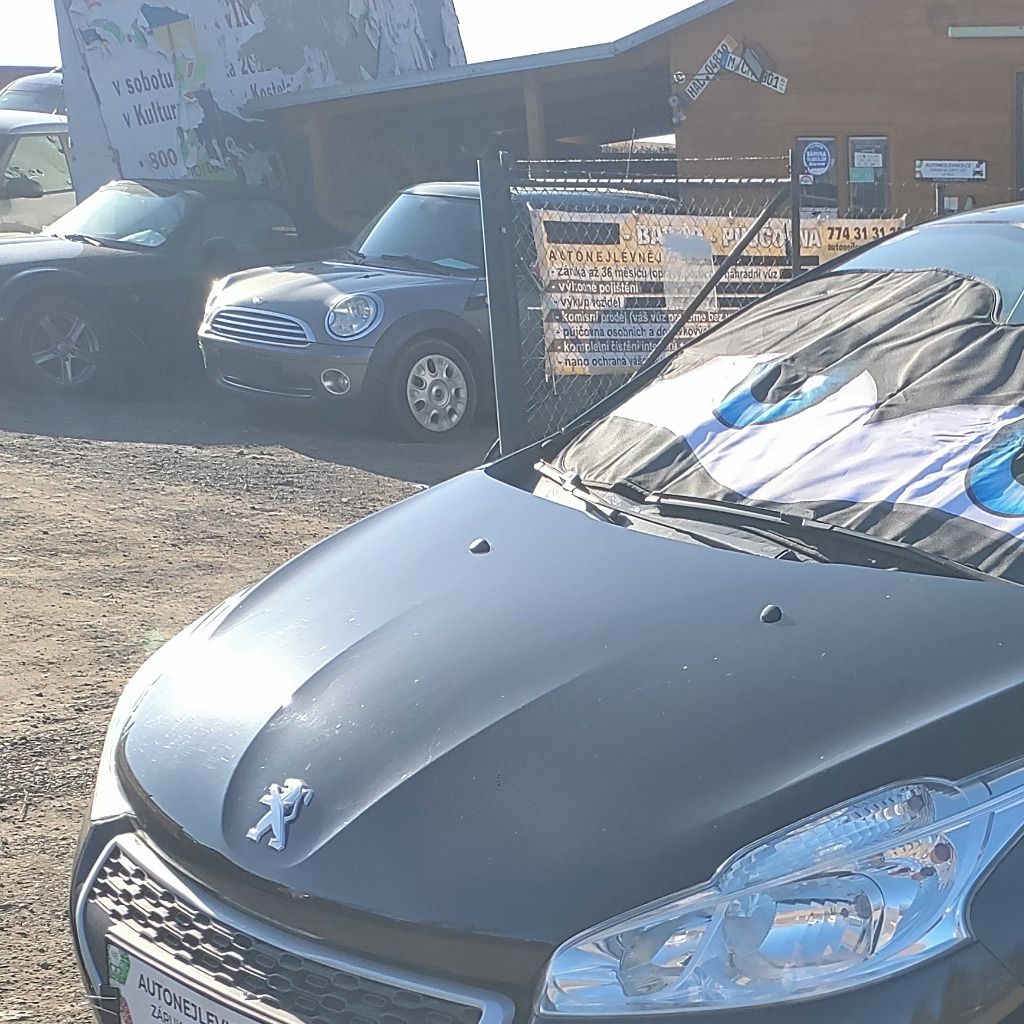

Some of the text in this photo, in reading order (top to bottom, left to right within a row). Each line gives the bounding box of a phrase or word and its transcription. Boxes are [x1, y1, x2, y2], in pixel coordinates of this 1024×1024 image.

[125, 68, 174, 95] sobotu
[133, 101, 180, 127] Kultur
[827, 226, 850, 240] 774
[854, 226, 867, 240] 31
[602, 266, 613, 278] 36
